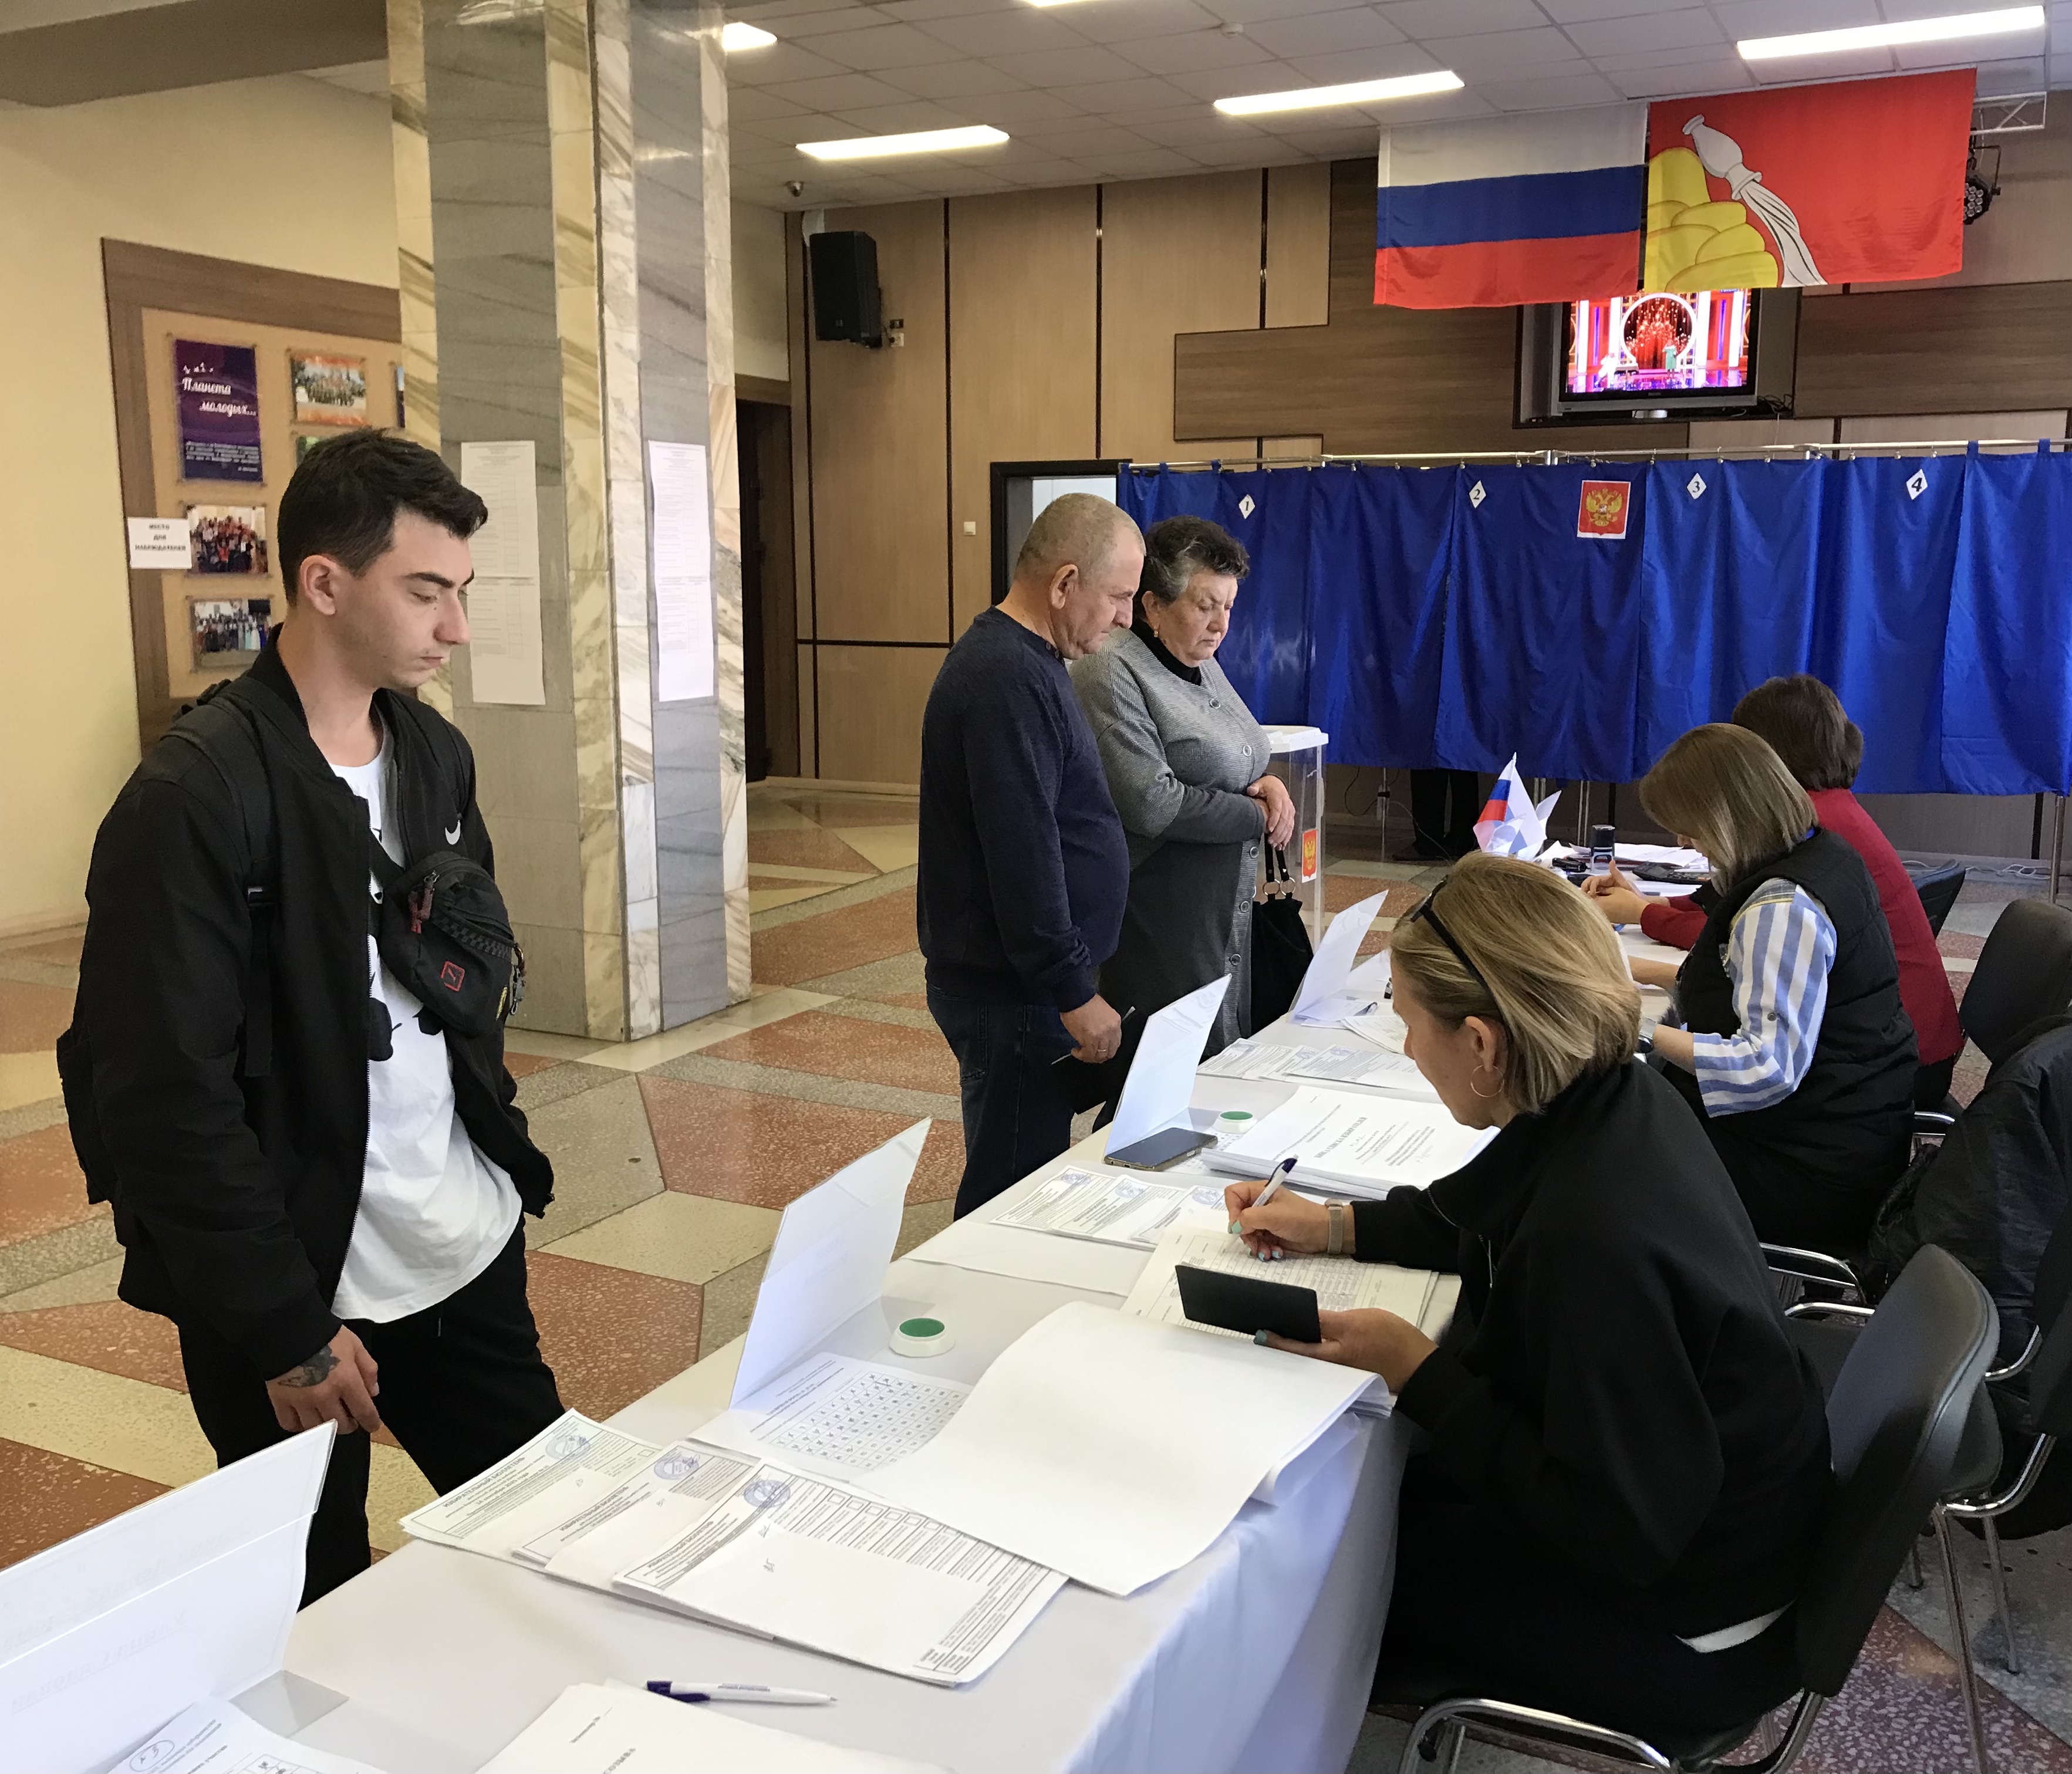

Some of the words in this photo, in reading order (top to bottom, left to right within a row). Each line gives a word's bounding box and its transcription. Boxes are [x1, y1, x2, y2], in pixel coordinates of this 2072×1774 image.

[182, 377, 231, 395] Планета
[1692, 481, 1700, 493] 3
[1911, 477, 1922, 492] 4
[1473, 488, 1481, 500] 2
[1245, 501, 1249, 511] 1
[443, 1478, 491, 1508] ИЗБИРАТЕЛЬНЫЙ
[491, 1457, 525, 1478] БЮЛЛЕТЕНЬ
